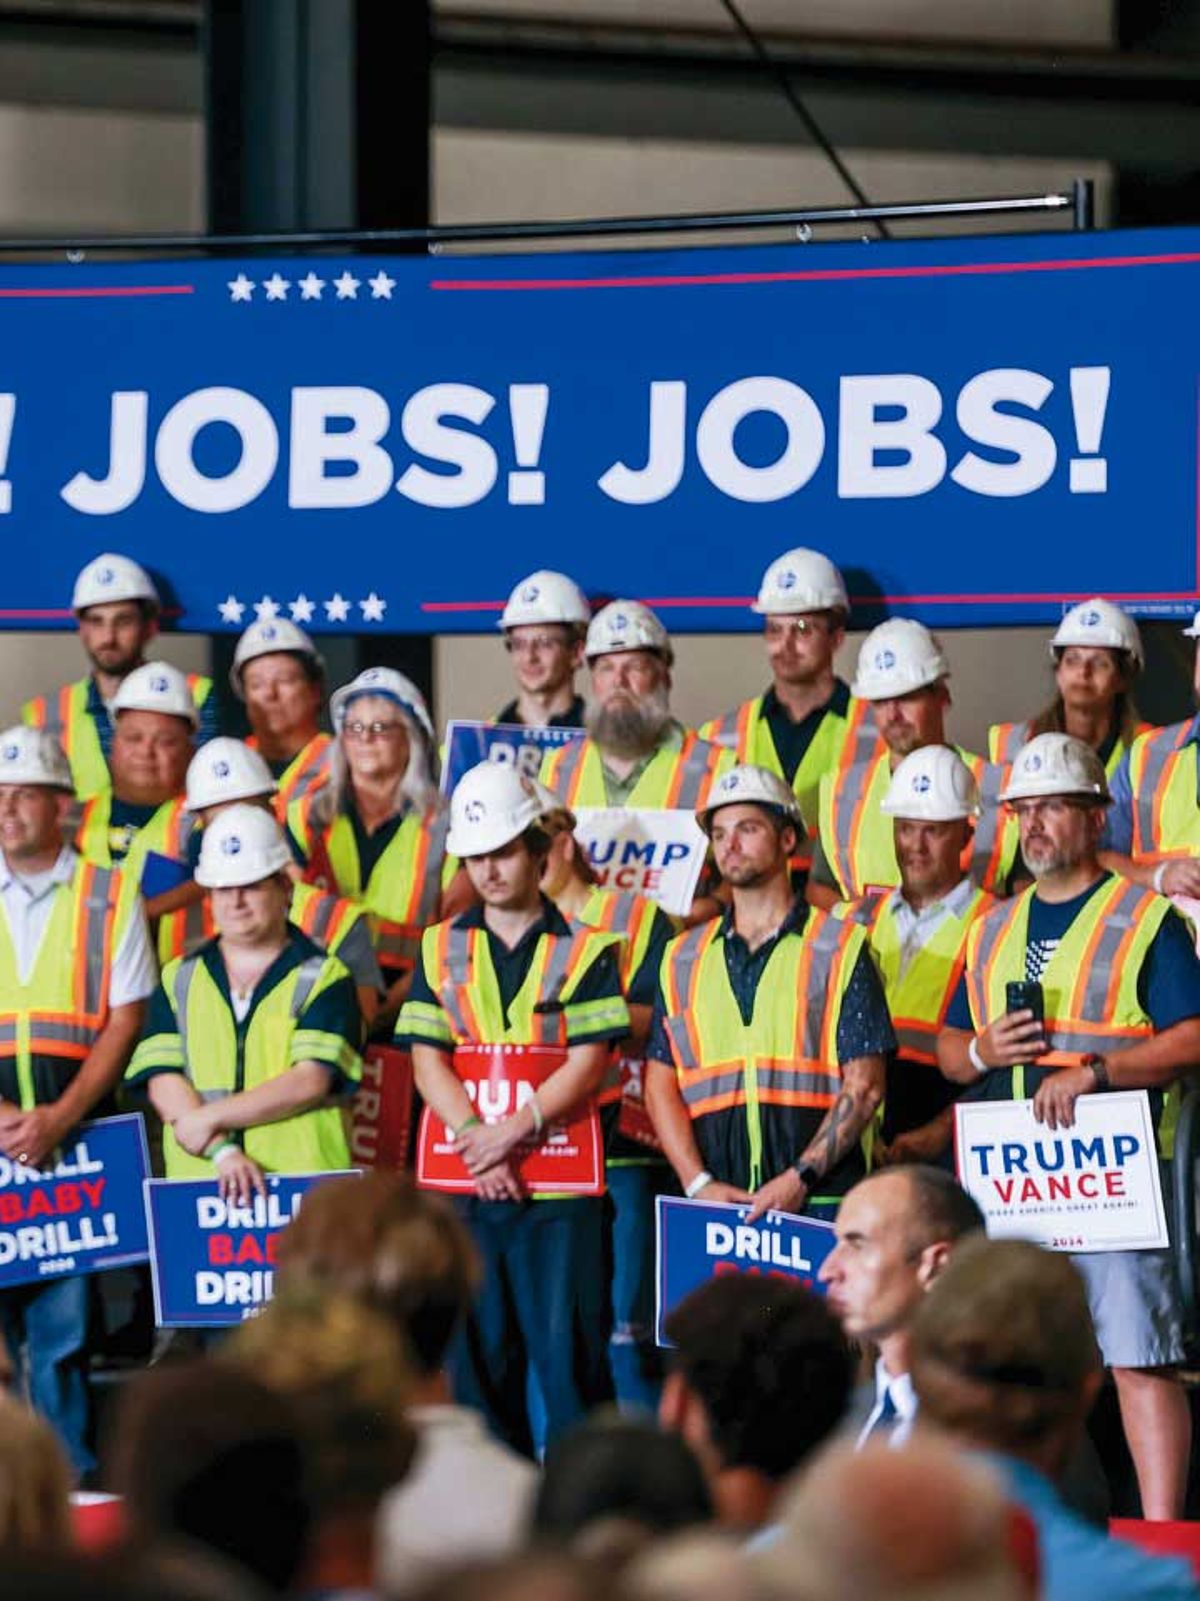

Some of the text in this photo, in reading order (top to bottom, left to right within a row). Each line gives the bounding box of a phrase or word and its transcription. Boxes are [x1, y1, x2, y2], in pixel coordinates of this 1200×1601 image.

[59, 383, 550, 515] JOBS!
[597, 365, 1112, 505] JOBS!
[588, 839, 690, 866] UMP
[590, 866, 663, 889] NCE
[971, 1135, 1140, 1176] TRUMP
[993, 1171, 1127, 1205] VANCE
[706, 1222, 812, 1272] DRILL
